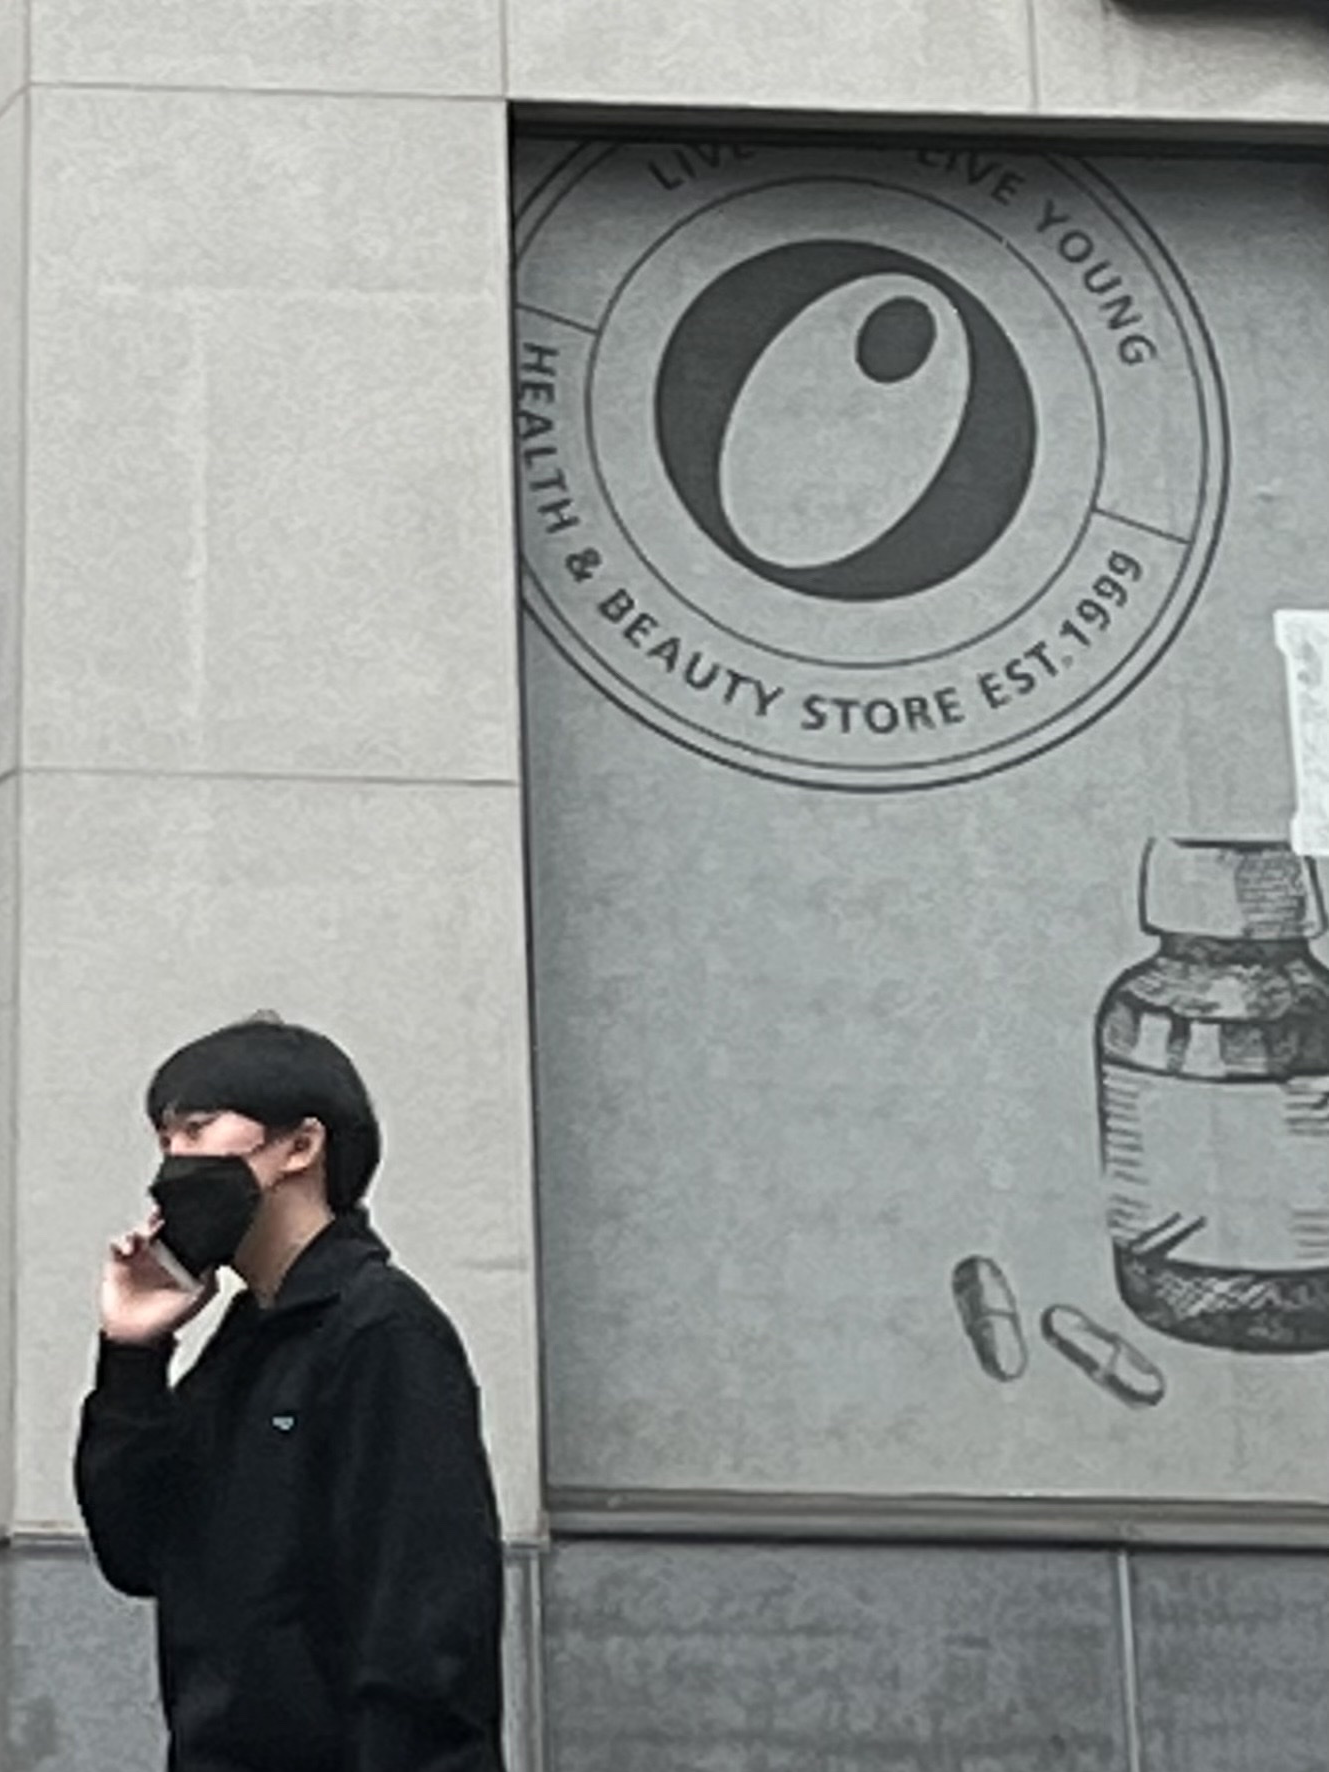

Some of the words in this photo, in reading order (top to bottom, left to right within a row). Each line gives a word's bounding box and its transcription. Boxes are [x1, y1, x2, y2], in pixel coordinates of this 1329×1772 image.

[1036, 199, 1159, 369] YOUNG
[516, 341, 581, 535] HEALTH
[564, 546, 603, 583] &
[597, 588, 785, 717] BEAUTY
[800, 686, 966, 735] STORE
